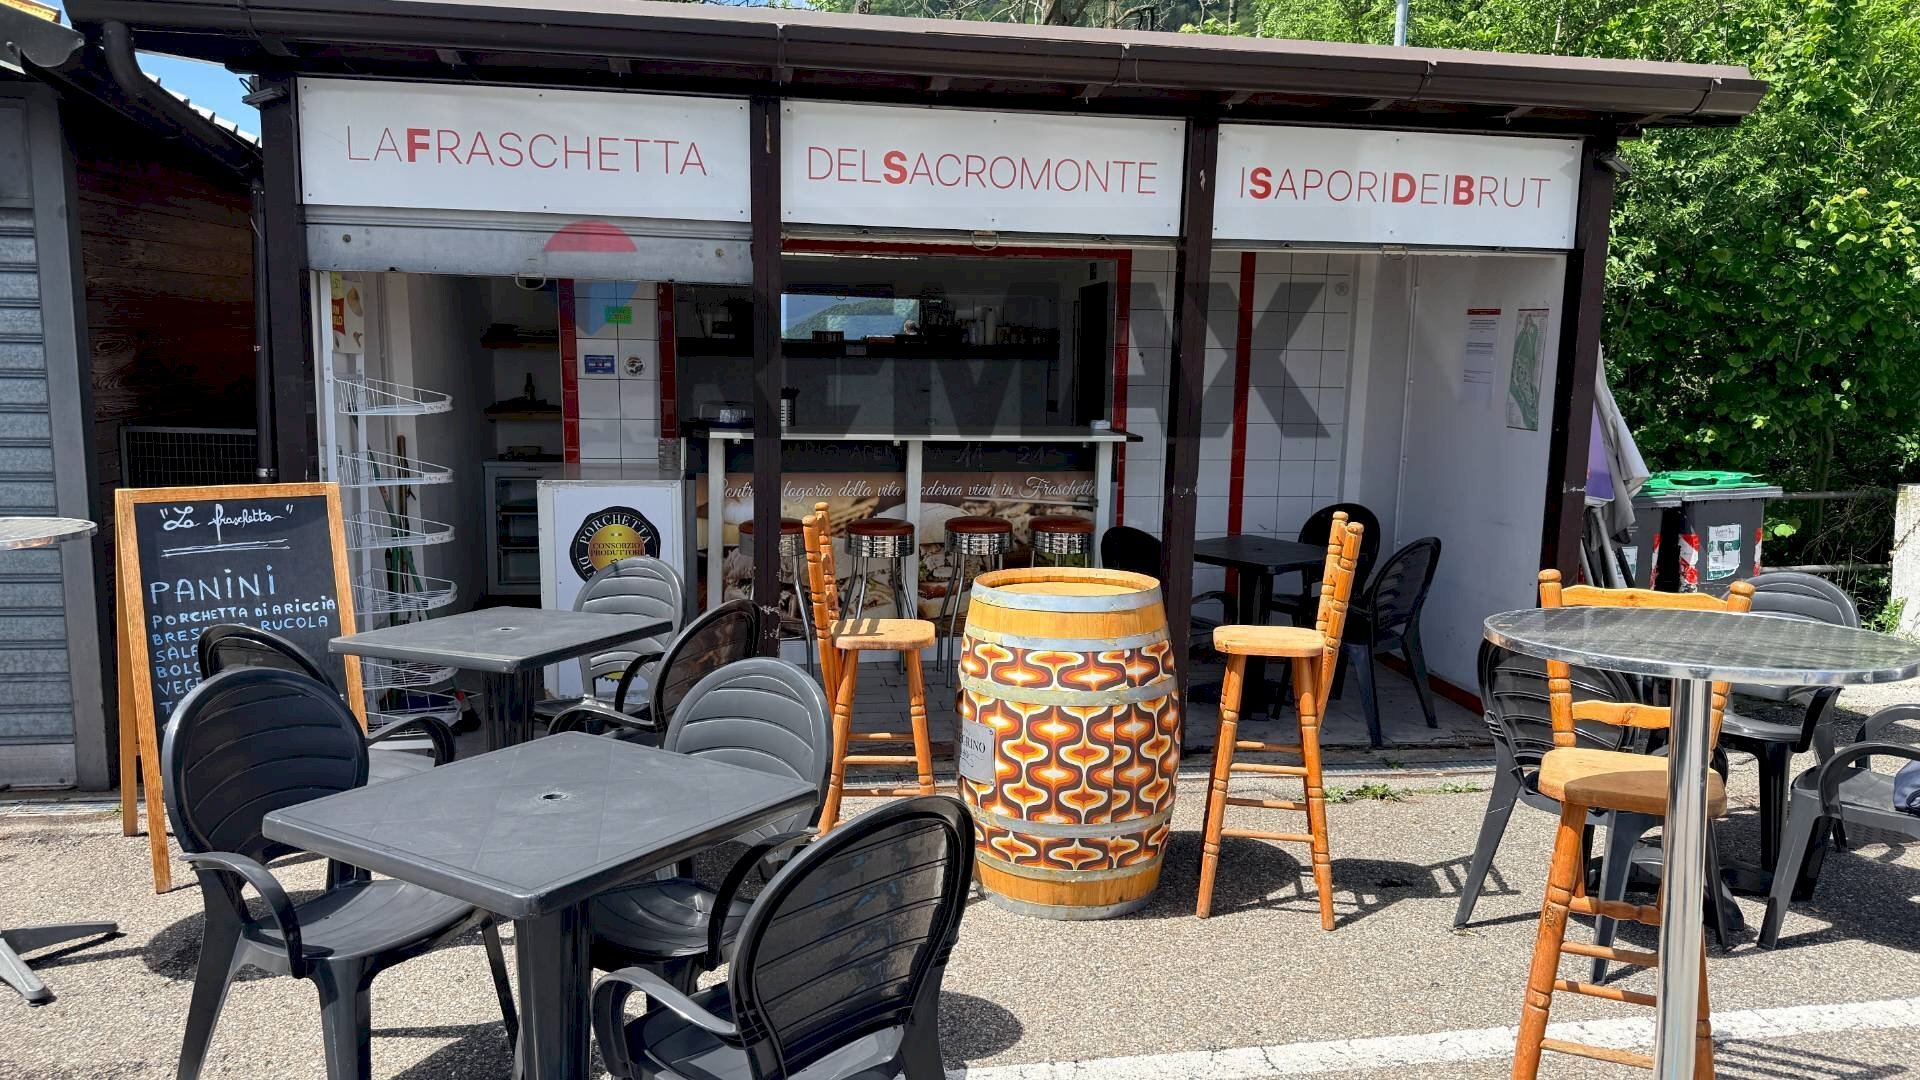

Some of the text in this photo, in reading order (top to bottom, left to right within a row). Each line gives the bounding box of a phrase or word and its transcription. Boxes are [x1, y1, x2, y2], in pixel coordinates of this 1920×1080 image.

[724, 479, 754, 498] ontr
[838, 481, 873, 497] della
[920, 480, 963, 496] oderna
[968, 482, 996, 496] vieni
[1001, 483, 1015, 496] in
[579, 514, 652, 546] PORCHETTA
[152, 606, 248, 627] PORCHETTA
[261, 615, 329, 632] RUCOLA
